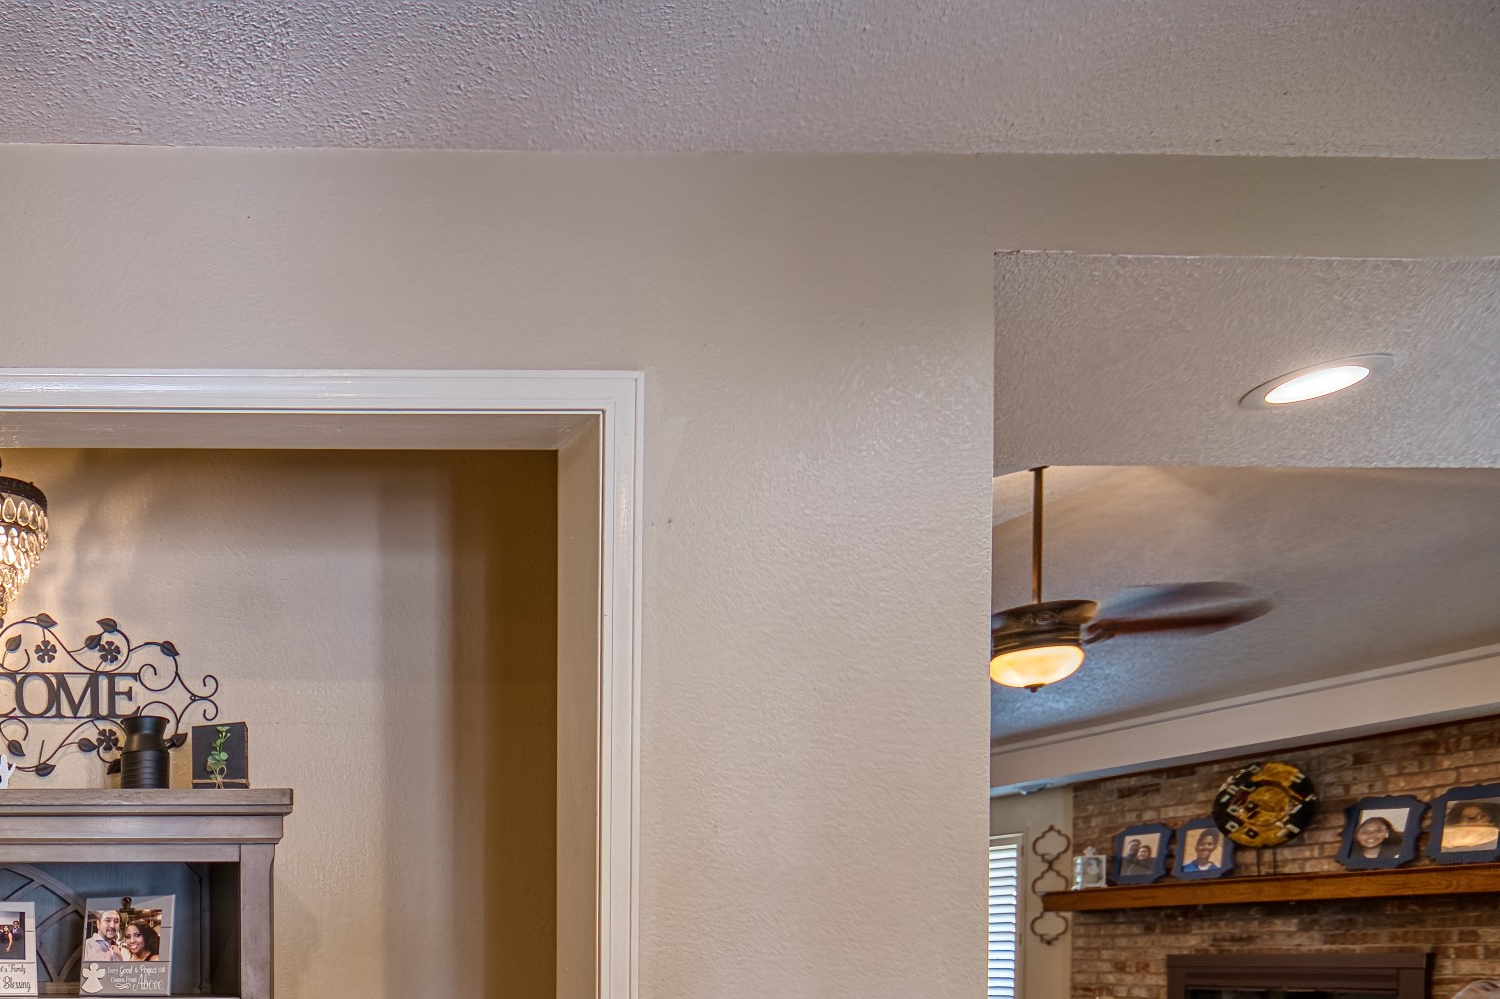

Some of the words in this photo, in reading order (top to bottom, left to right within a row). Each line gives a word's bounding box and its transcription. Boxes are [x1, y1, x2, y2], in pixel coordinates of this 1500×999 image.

[8, 964, 26, 974] Family
[119, 965, 133, 978] Good
[3, 976, 31, 992] Blessing
[133, 974, 164, 991] Above
